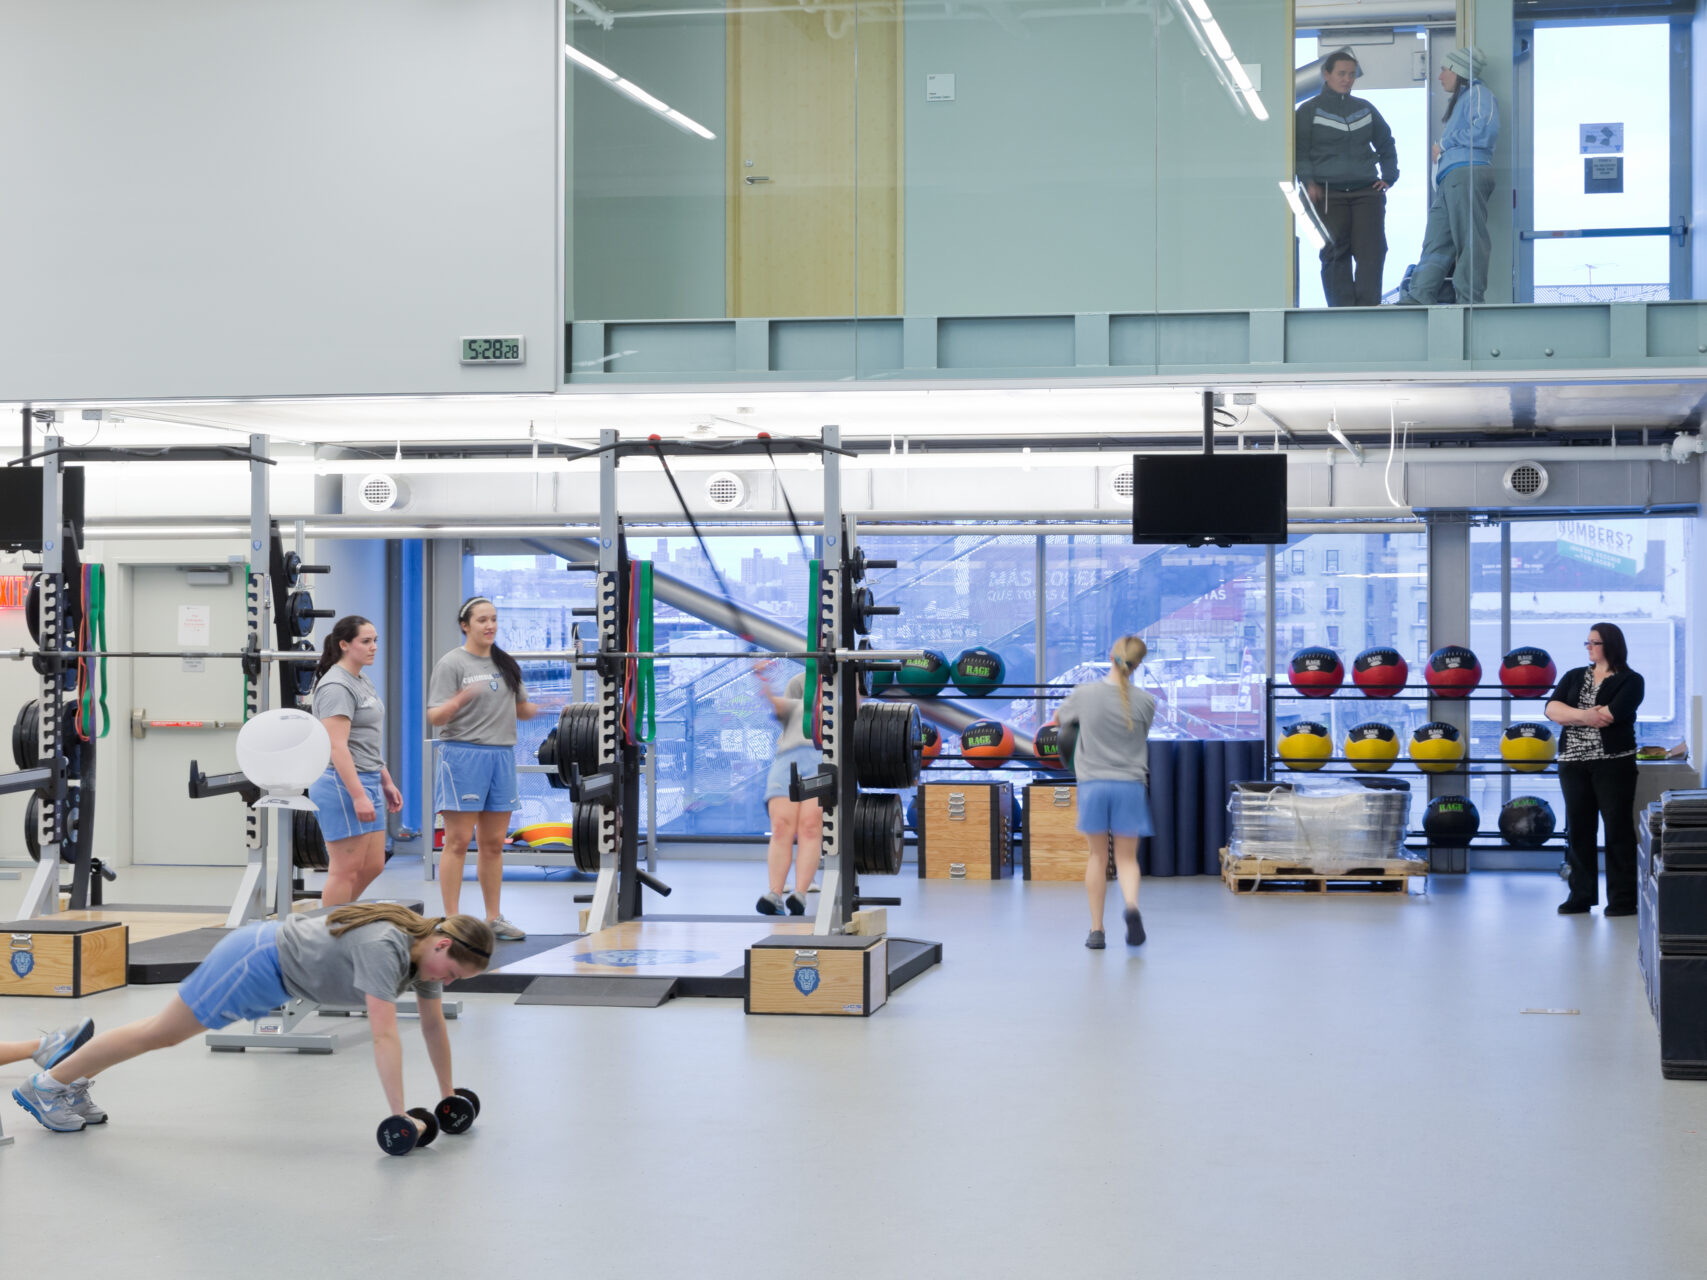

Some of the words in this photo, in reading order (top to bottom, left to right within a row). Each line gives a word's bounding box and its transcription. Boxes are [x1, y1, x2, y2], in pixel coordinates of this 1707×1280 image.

[468, 340, 503, 360] 5:28
[504, 345, 519, 359] 28
[966, 665, 991, 677] RAGE
[968, 735, 992, 747] RAGE
[1440, 803, 1463, 813] RAGE
